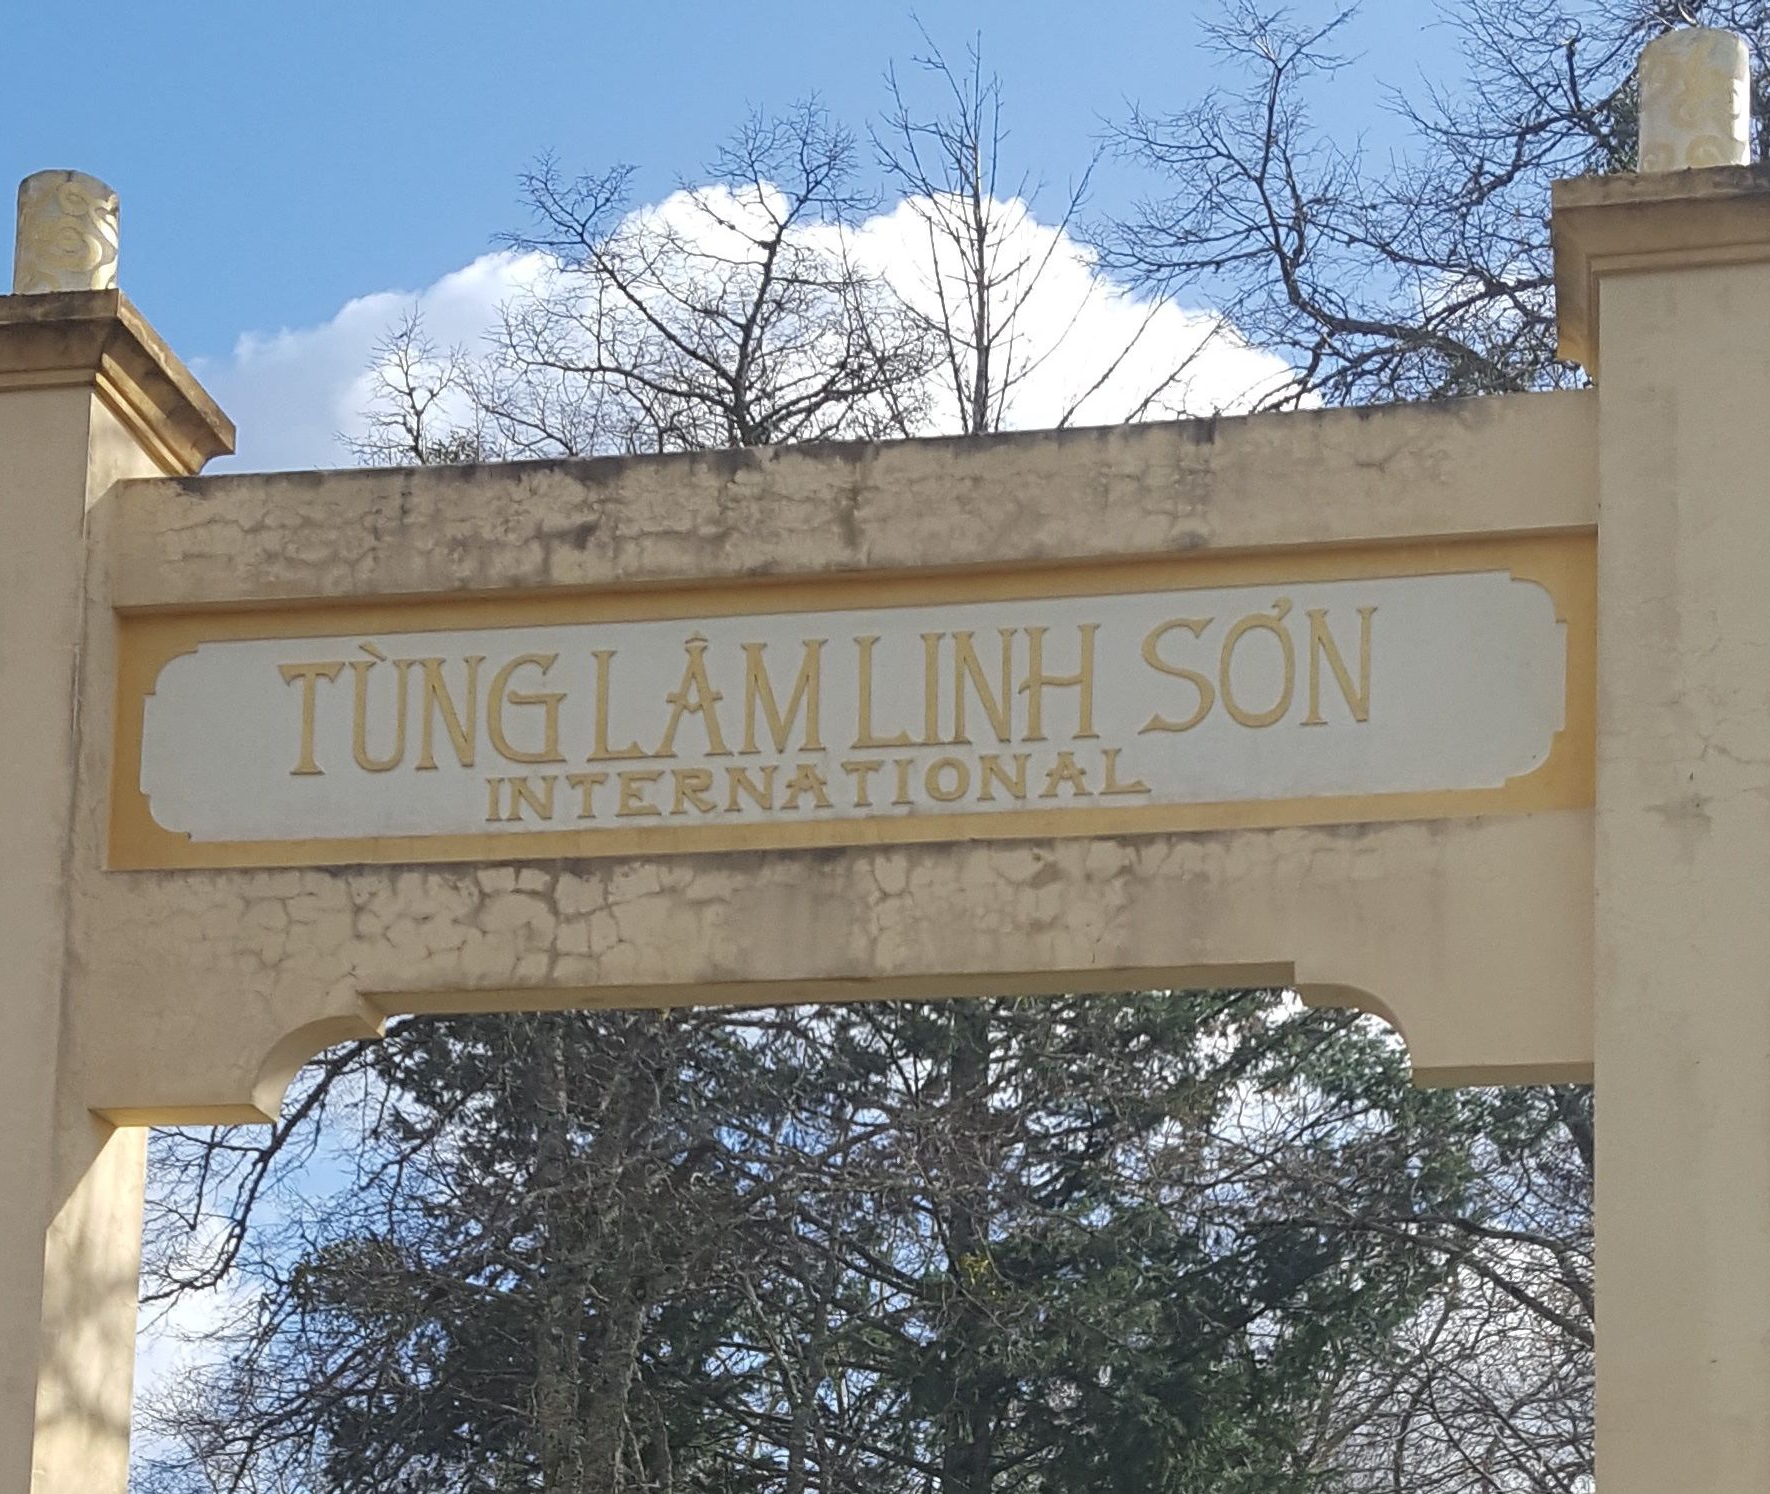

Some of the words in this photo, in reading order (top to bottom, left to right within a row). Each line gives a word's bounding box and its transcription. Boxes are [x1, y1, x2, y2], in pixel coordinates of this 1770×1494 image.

[277, 640, 568, 776] TÙNG
[586, 629, 829, 763] LÂM
[849, 622, 1102, 750] LINH
[1136, 596, 1379, 736] SƠN
[484, 747, 1152, 822] INTERNATIONAL
